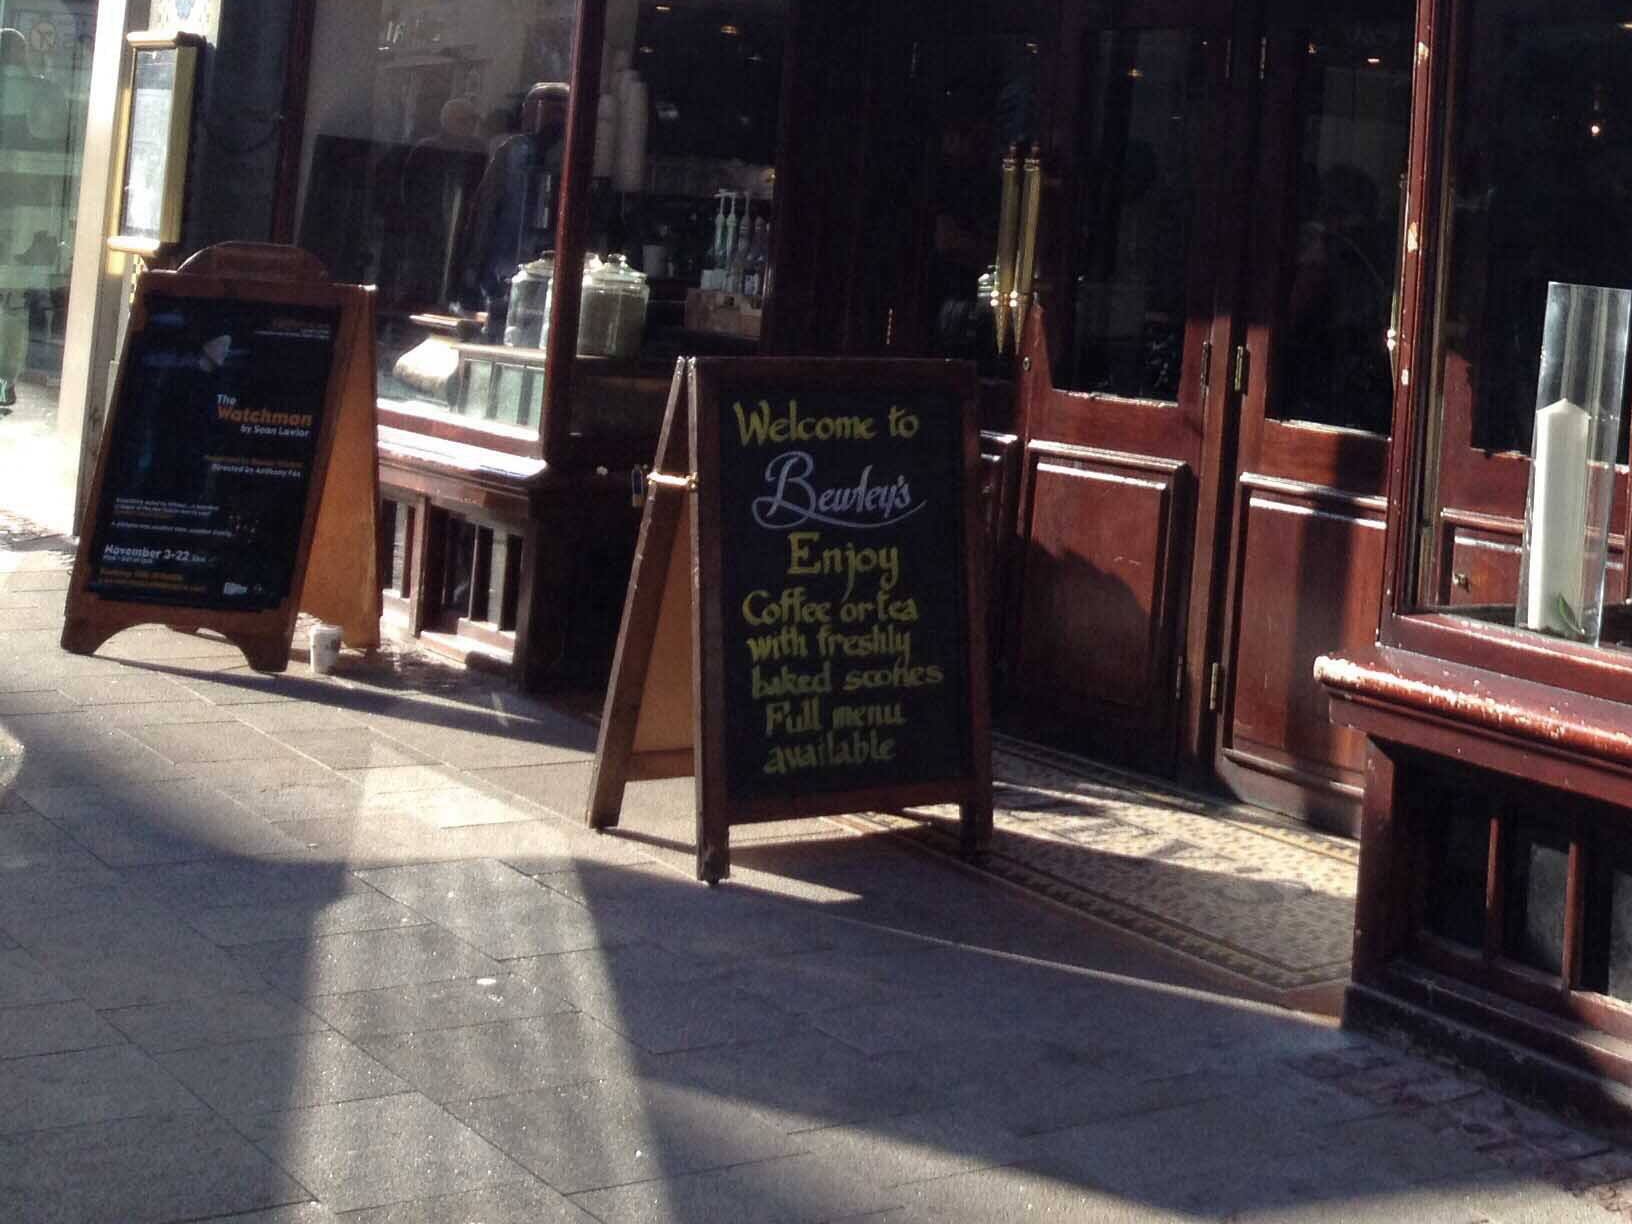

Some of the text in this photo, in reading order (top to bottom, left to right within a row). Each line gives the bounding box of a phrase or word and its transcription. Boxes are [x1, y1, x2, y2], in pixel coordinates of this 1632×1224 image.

[216, 393, 237, 406] The
[217, 405, 313, 426] Watchman
[733, 400, 920, 446] Welcome to
[752, 450, 928, 529] Bewley's
[104, 543, 161, 558] November
[787, 532, 901, 600] Enjoy
[742, 586, 920, 626] Coffee or tea
[746, 624, 912, 668] with freshly
[752, 661, 944, 699] baked scones
[766, 697, 908, 736] Full menu
[763, 728, 897, 774] available
